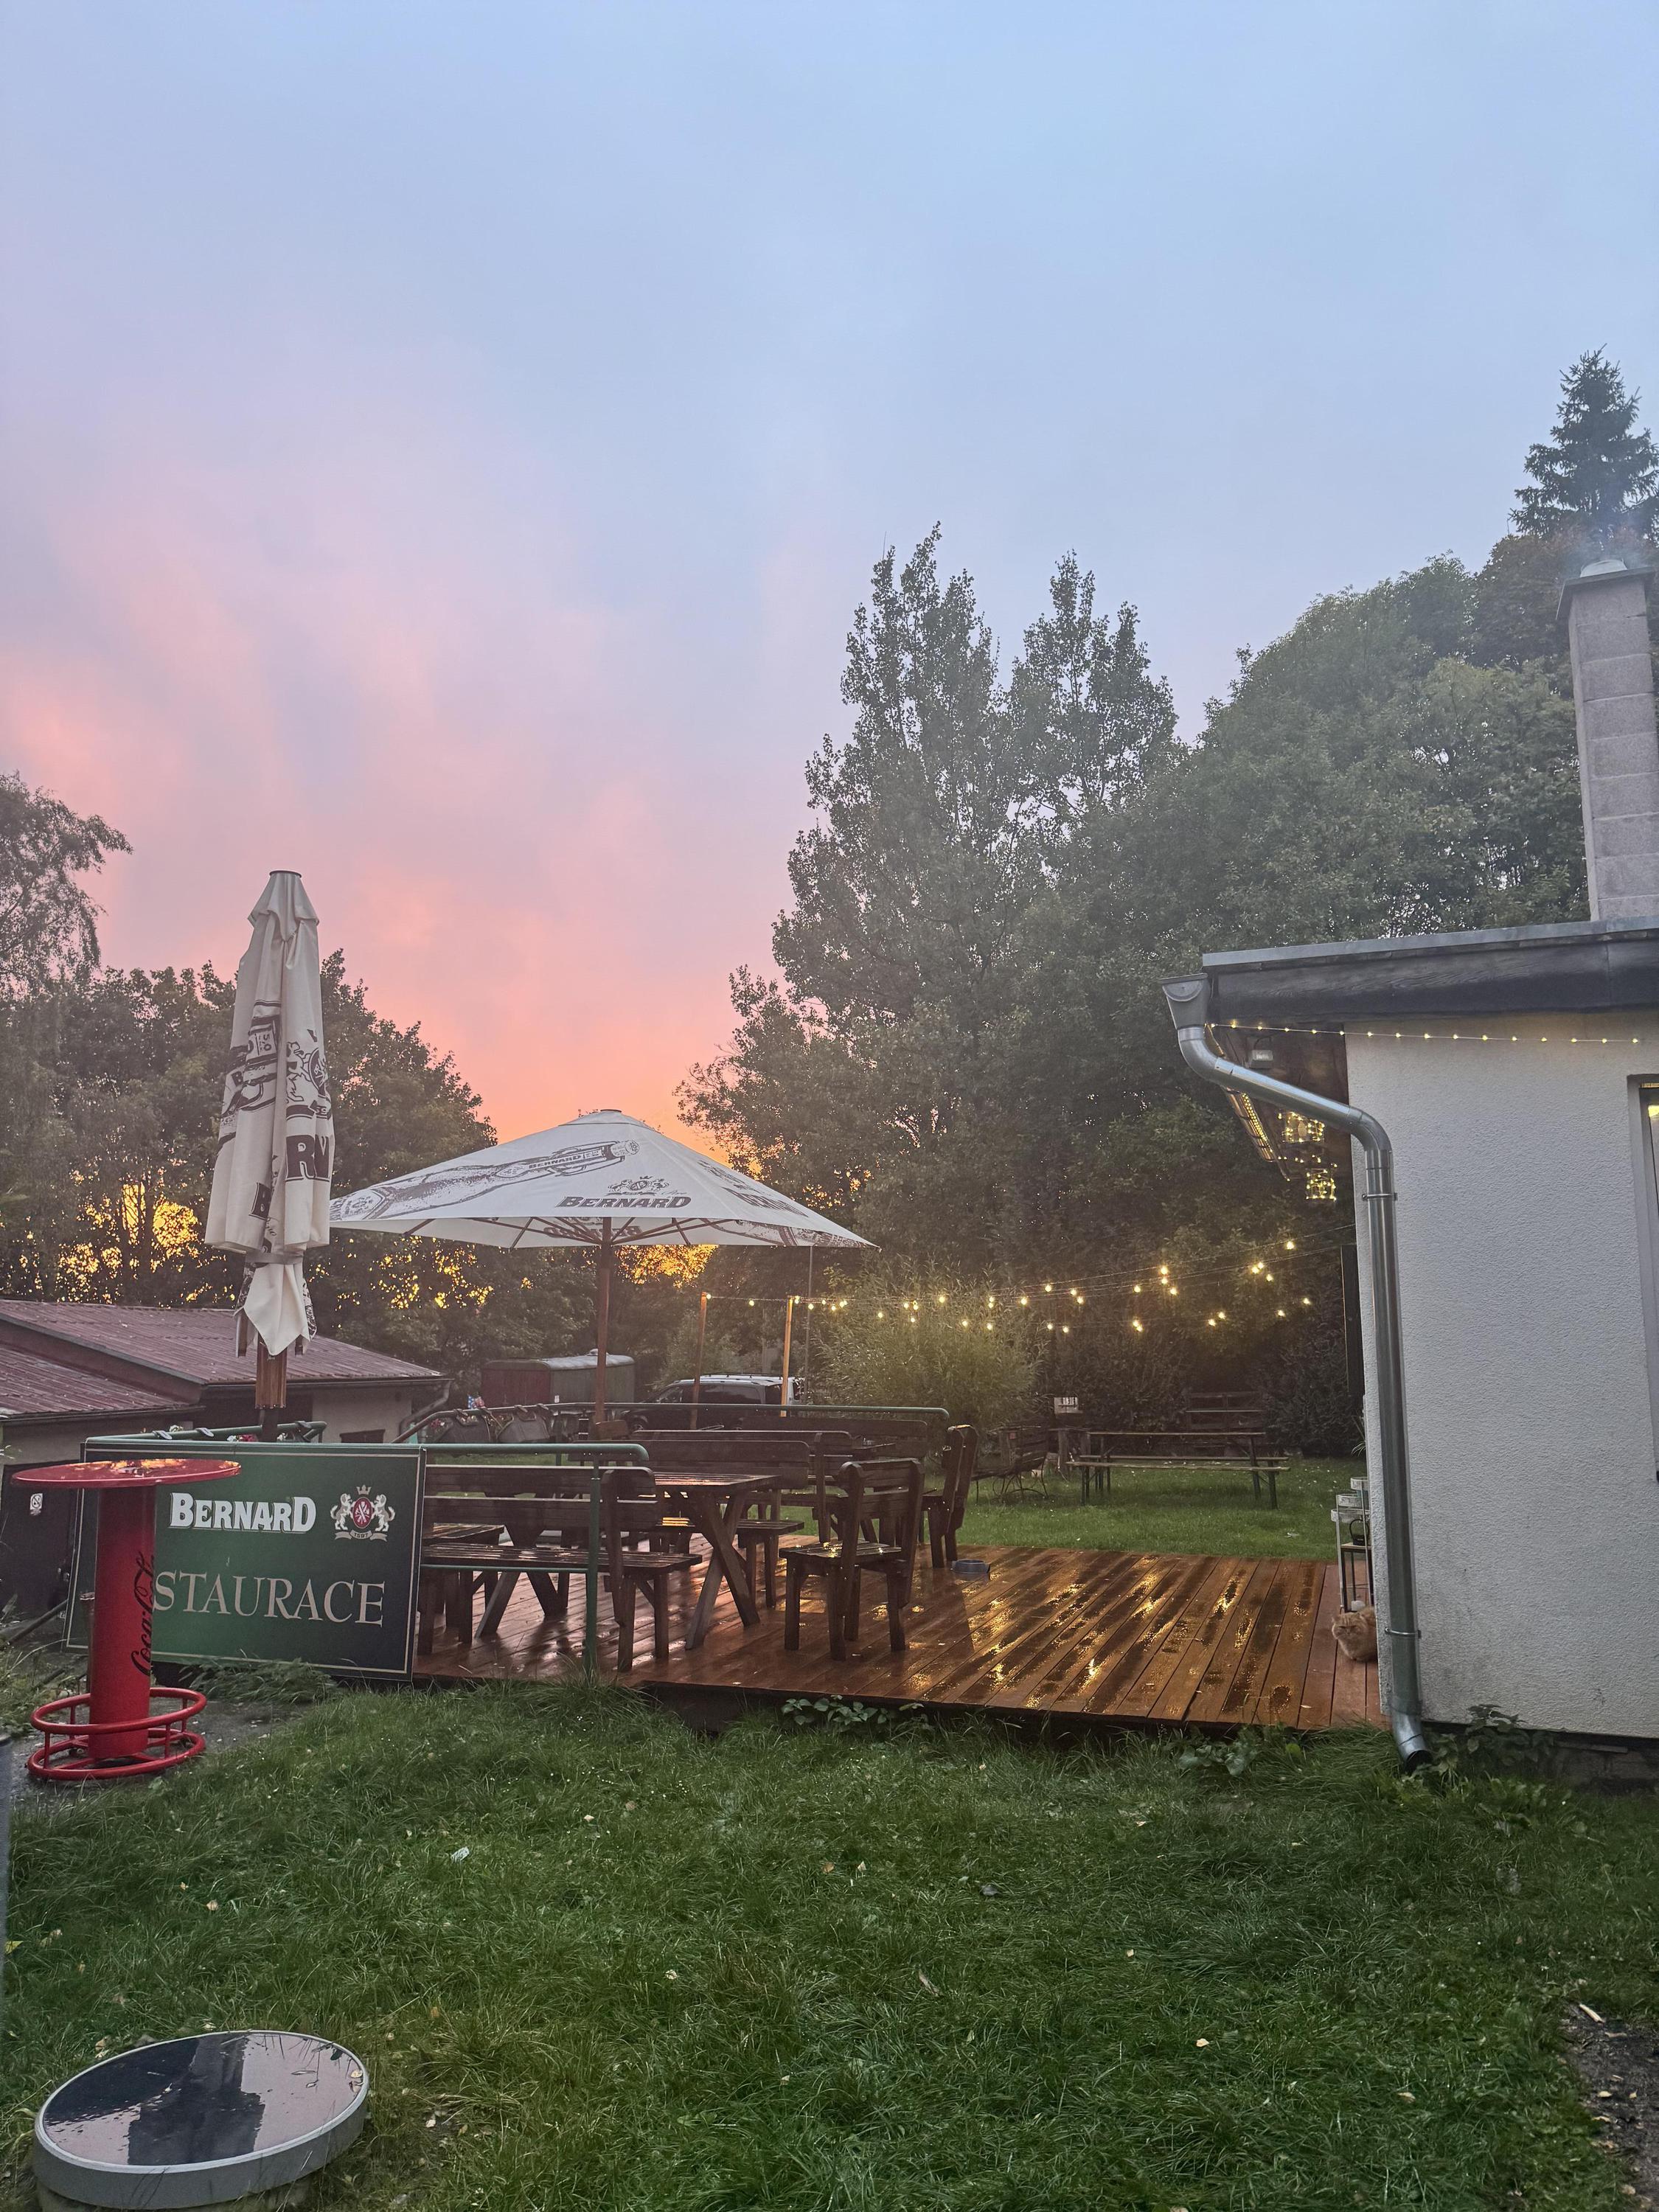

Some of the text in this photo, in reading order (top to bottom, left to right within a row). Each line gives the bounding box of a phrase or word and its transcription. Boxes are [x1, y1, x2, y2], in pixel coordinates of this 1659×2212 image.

[554, 1196, 692, 1208] BERNARD
[169, 1492, 316, 1534] BERNARD
[153, 1570, 386, 1627] STAURACE
